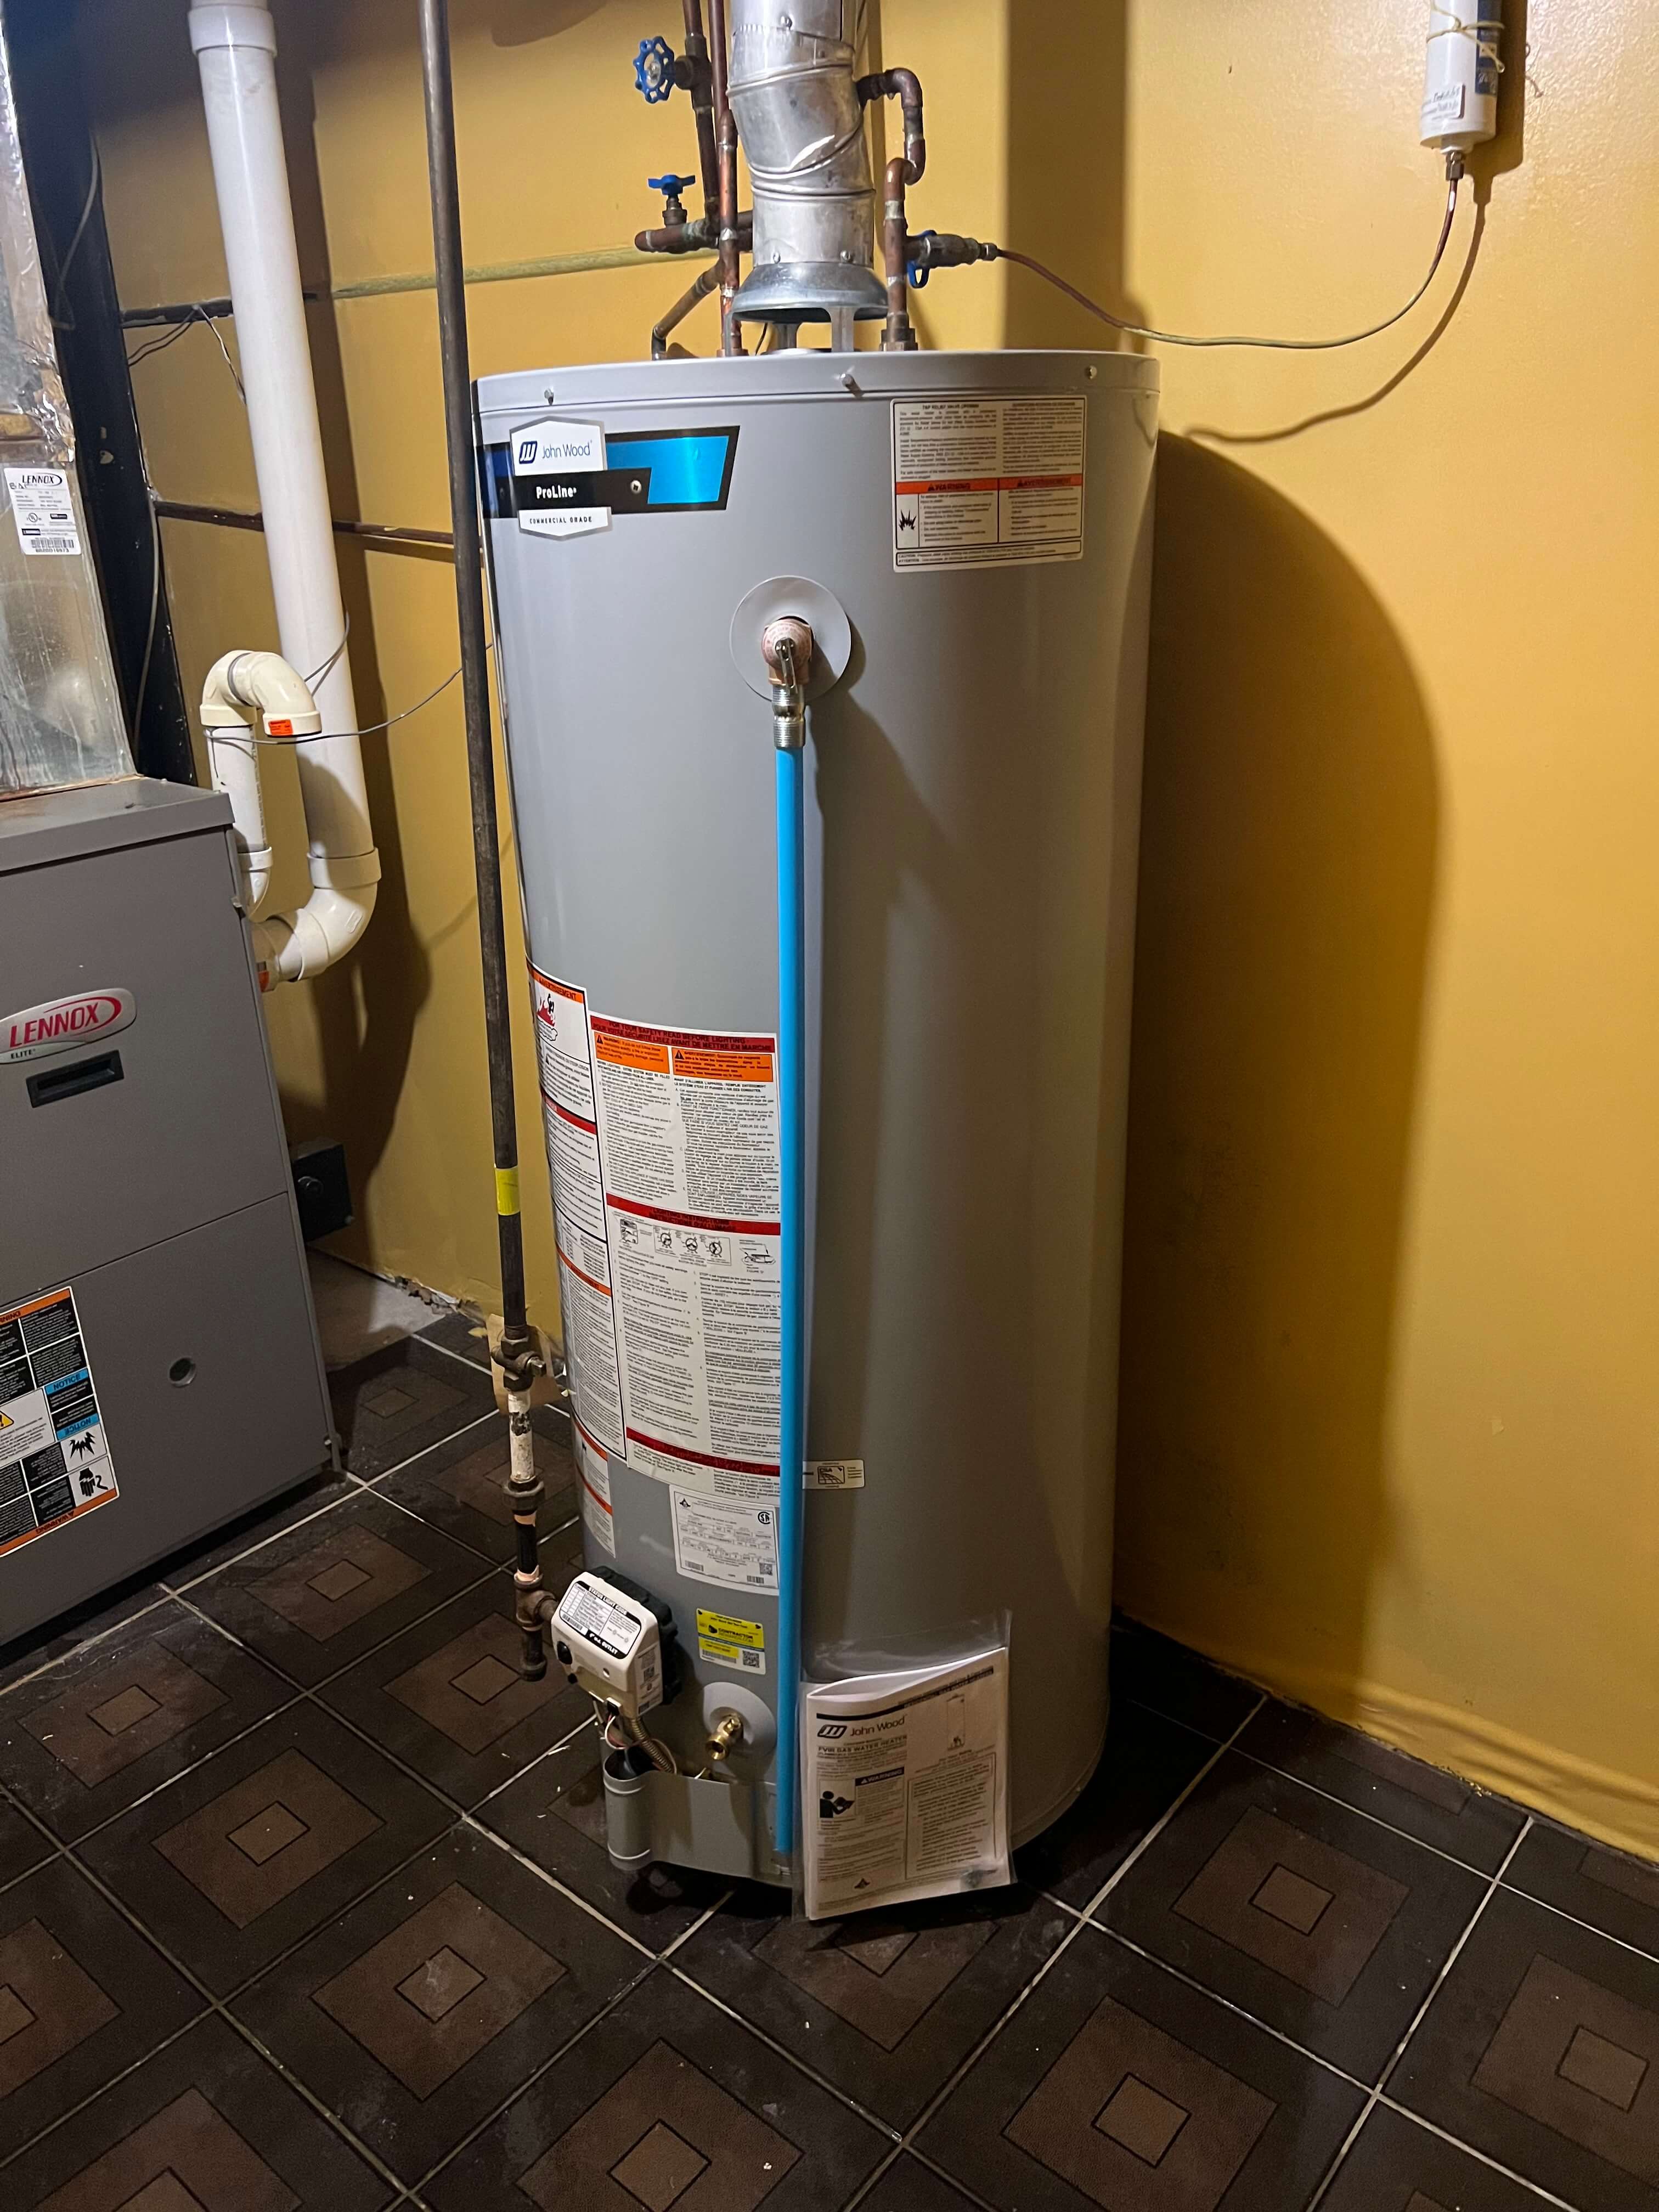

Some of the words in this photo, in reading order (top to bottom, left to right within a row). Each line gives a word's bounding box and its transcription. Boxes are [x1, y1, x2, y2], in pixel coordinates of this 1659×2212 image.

[542, 444, 562, 459] John
[563, 442, 590, 457] Wood
[22, 475, 54, 484] LENNOX
[9, 1002, 99, 1048] LENNOX
[638, 1026, 663, 1036] SAFETY
[682, 1034, 709, 1042] BEFORE
[702, 1041, 730, 1049] METTRE
[53, 1373, 81, 1390] NOTICE
[64, 1417, 92, 1435] NOTICE
[850, 1726, 875, 1737] John
[876, 1716, 905, 1732] Wood
[854, 1741, 878, 1752] WATER
